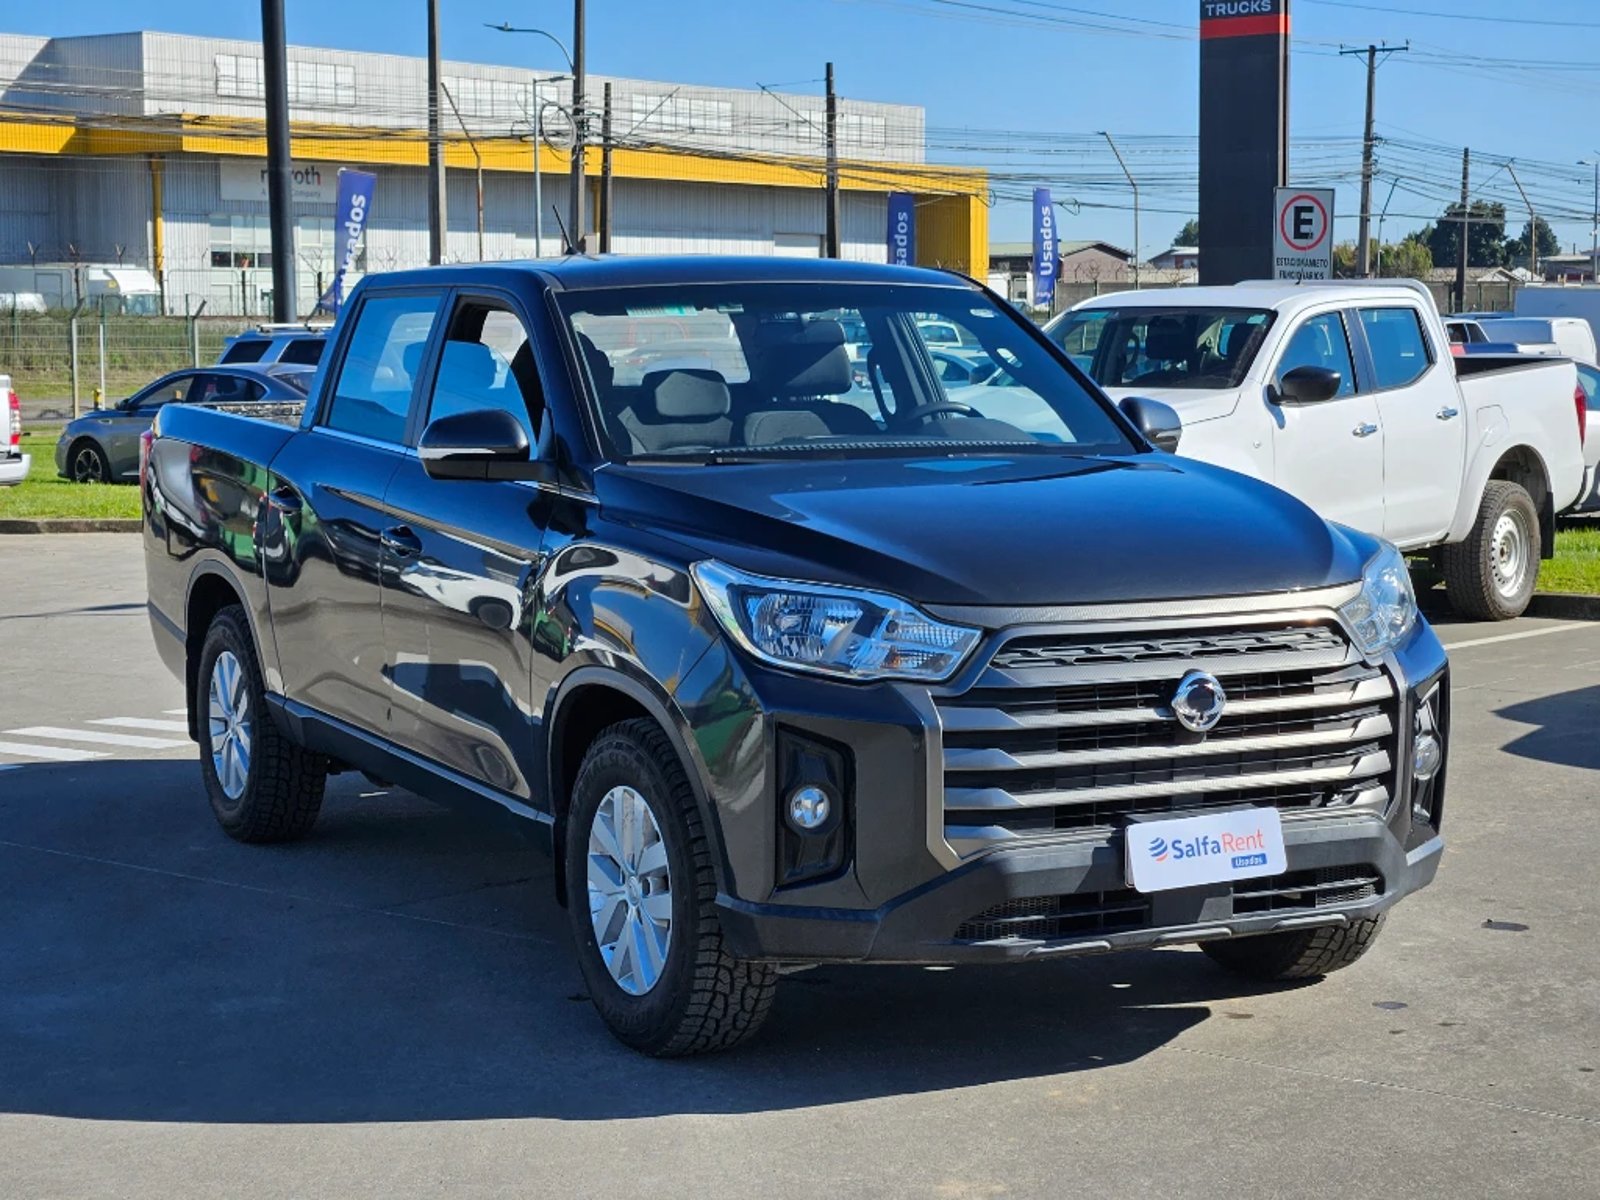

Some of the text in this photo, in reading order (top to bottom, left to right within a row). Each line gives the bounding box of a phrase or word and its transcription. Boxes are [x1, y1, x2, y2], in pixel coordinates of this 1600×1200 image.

[1205, 0, 1272, 17] TRUCKS
[894, 211, 908, 267] sados
[1294, 206, 1315, 240] E
[1040, 205, 1053, 277] Usados
[1235, 855, 1264, 867] Usados
